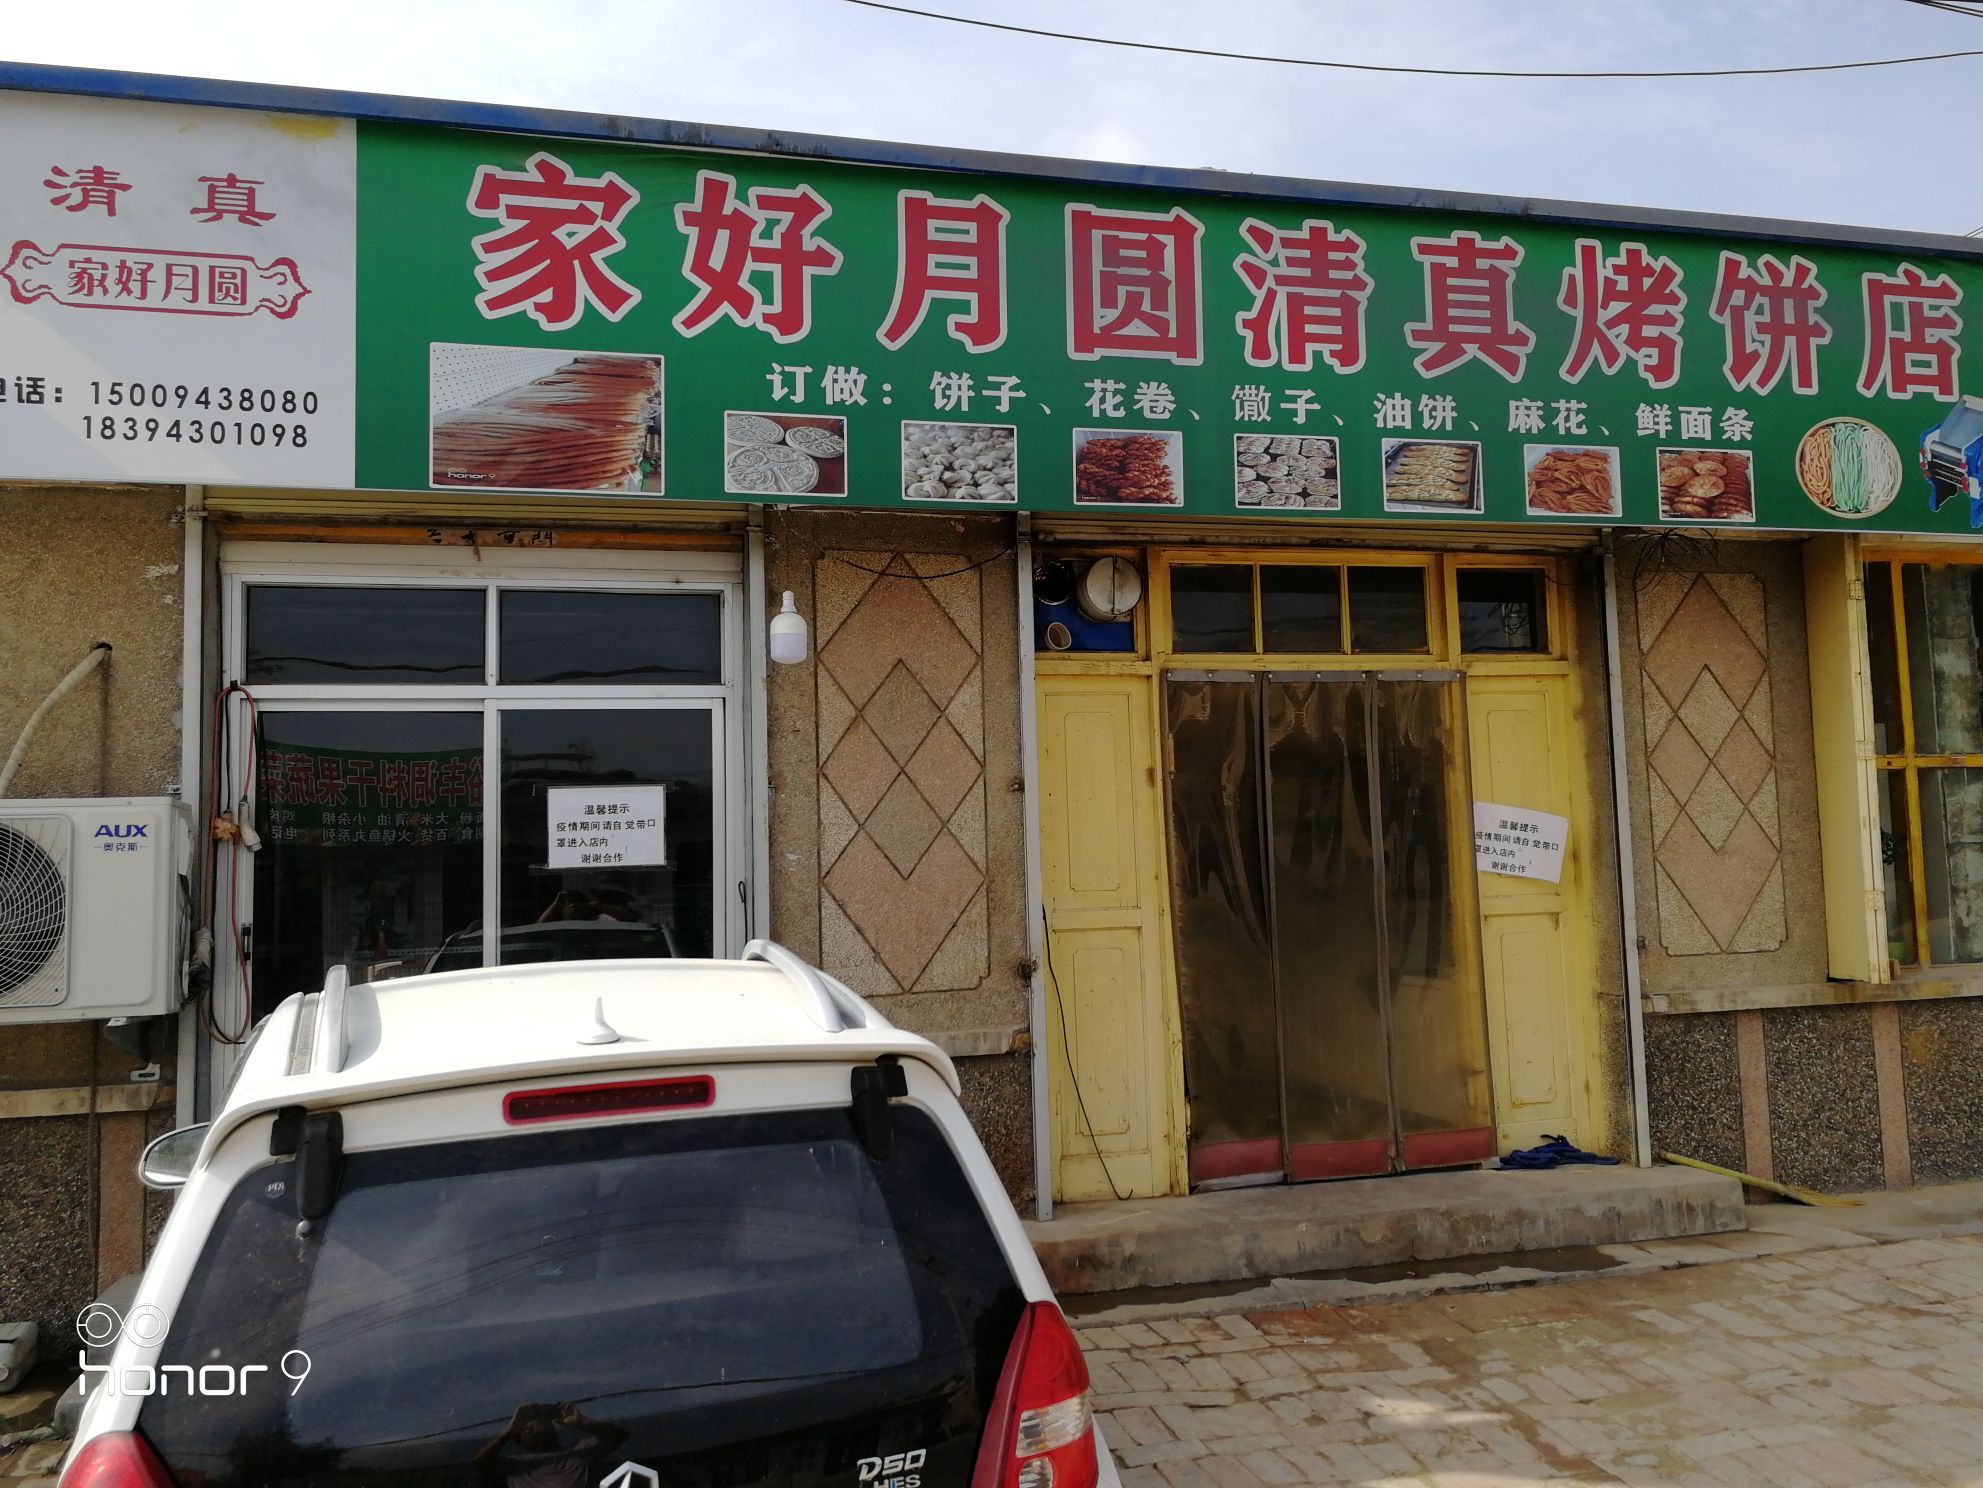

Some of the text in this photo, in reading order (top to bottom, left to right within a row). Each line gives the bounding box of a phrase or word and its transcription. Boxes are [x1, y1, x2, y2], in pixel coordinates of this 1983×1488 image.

[68, 257, 247, 305] 家好月圆
[467, 150, 1964, 401] 家好月圆清真烤饼店
[90, 381, 318, 415] 15009438080
[82, 415, 308, 448] 18394301098
[584, 803, 630, 815] 温馨提示
[94, 824, 148, 838] AUX
[1498, 819, 1540, 834] 温馨提示
[103, 842, 138, 852] 奥克斯
[857, 1448, 927, 1481] D50
